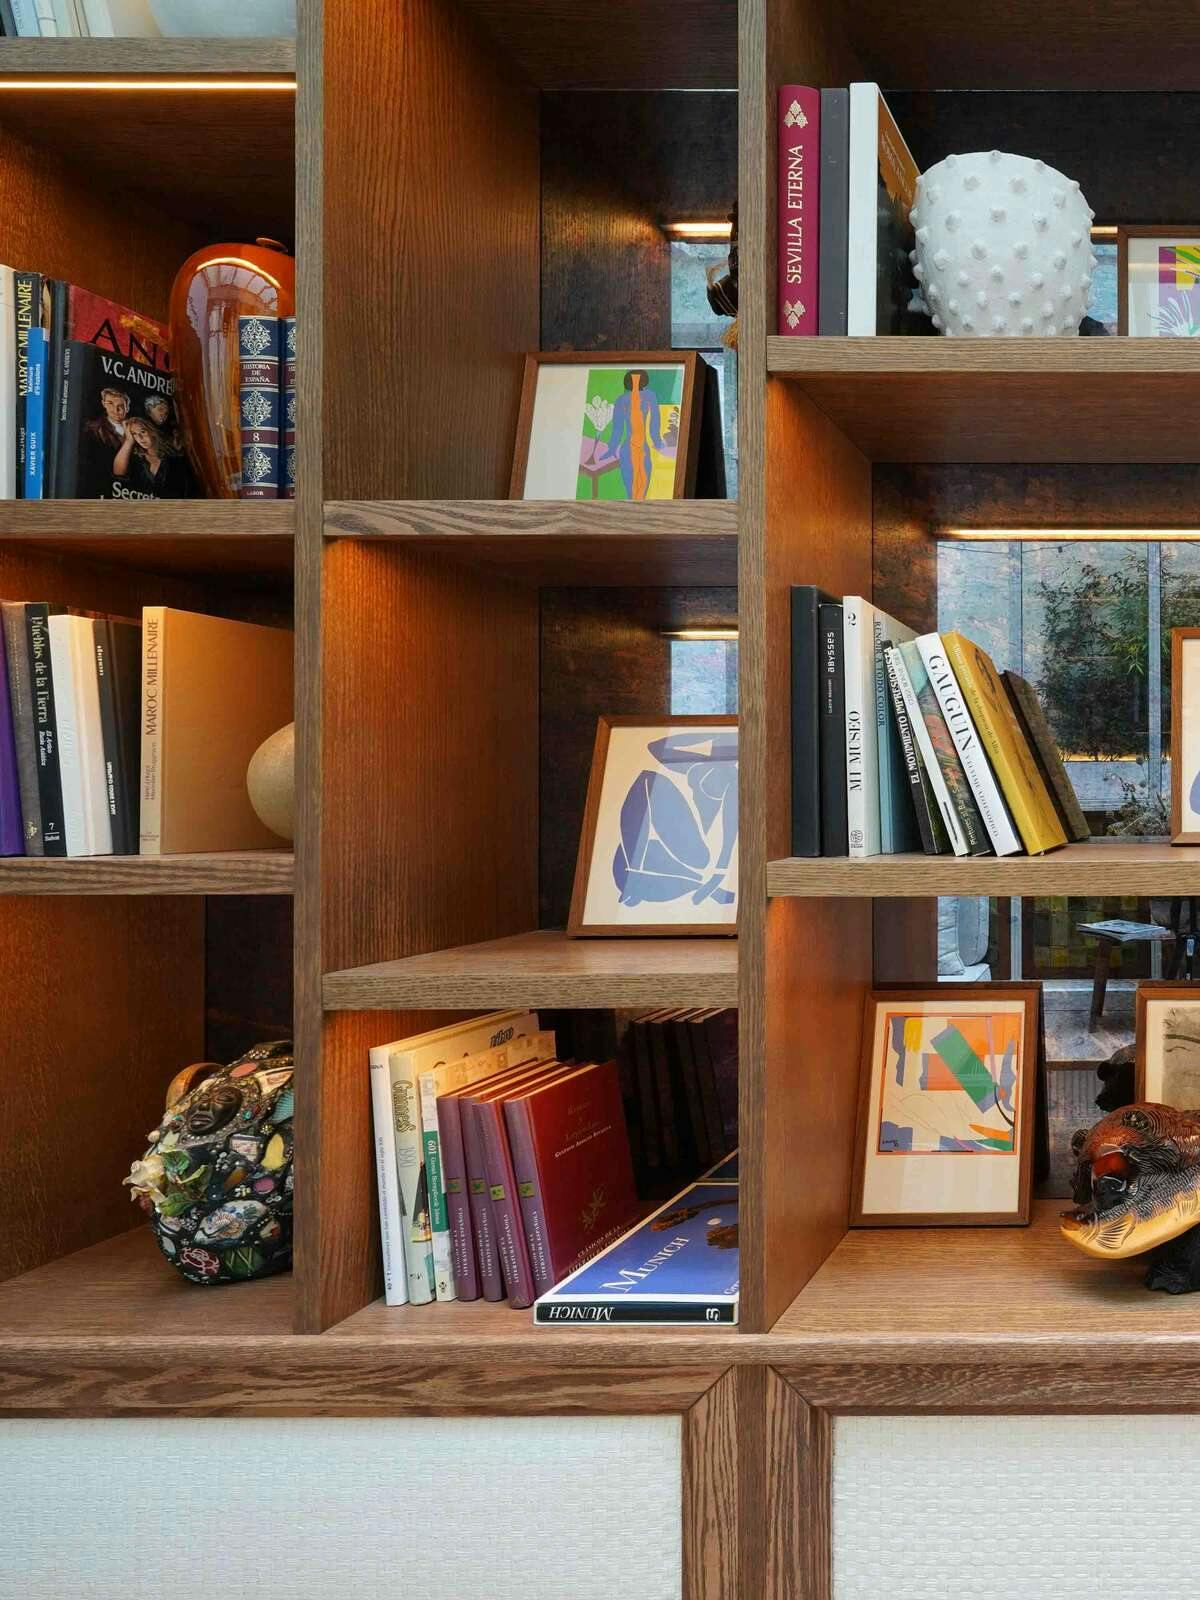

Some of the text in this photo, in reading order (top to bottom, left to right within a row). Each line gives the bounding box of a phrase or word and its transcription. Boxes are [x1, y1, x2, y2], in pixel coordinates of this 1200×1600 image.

[786, 145, 803, 284] SEVILLA ETERNA
[18, 280, 31, 347] MILLENAIRE
[19, 348, 28, 397] MAROC
[100, 355, 126, 380] V.C.
[242, 363, 271, 371] HISTORIA
[244, 375, 270, 384] ESPAÑA
[252, 431, 260, 442] 8
[874, 621, 883, 656] RENOIR
[34, 661, 47, 676] de
[35, 677, 47, 687] la
[146, 619, 157, 736] MAROC MILLENAIRE
[876, 665, 885, 693] TODO
[877, 694, 886, 728] COLOR
[926, 652, 978, 755] GAUGUIN
[849, 710, 862, 792] MI MUSEO
[898, 715, 917, 772] MOVIMIENTO
[910, 772, 920, 784] EL
[393, 1079, 415, 1132] Guinness
[427, 1139, 436, 1156] 601
[460, 1237, 468, 1276] LITERATURA
[503, 1213, 520, 1283] LITERATURA ESPAÑOLA
[532, 1210, 548, 1280] LITERATURA ESPAÑOLA
[601, 1236, 690, 1293] MUNICH
[549, 1306, 615, 1321] MUNICH
